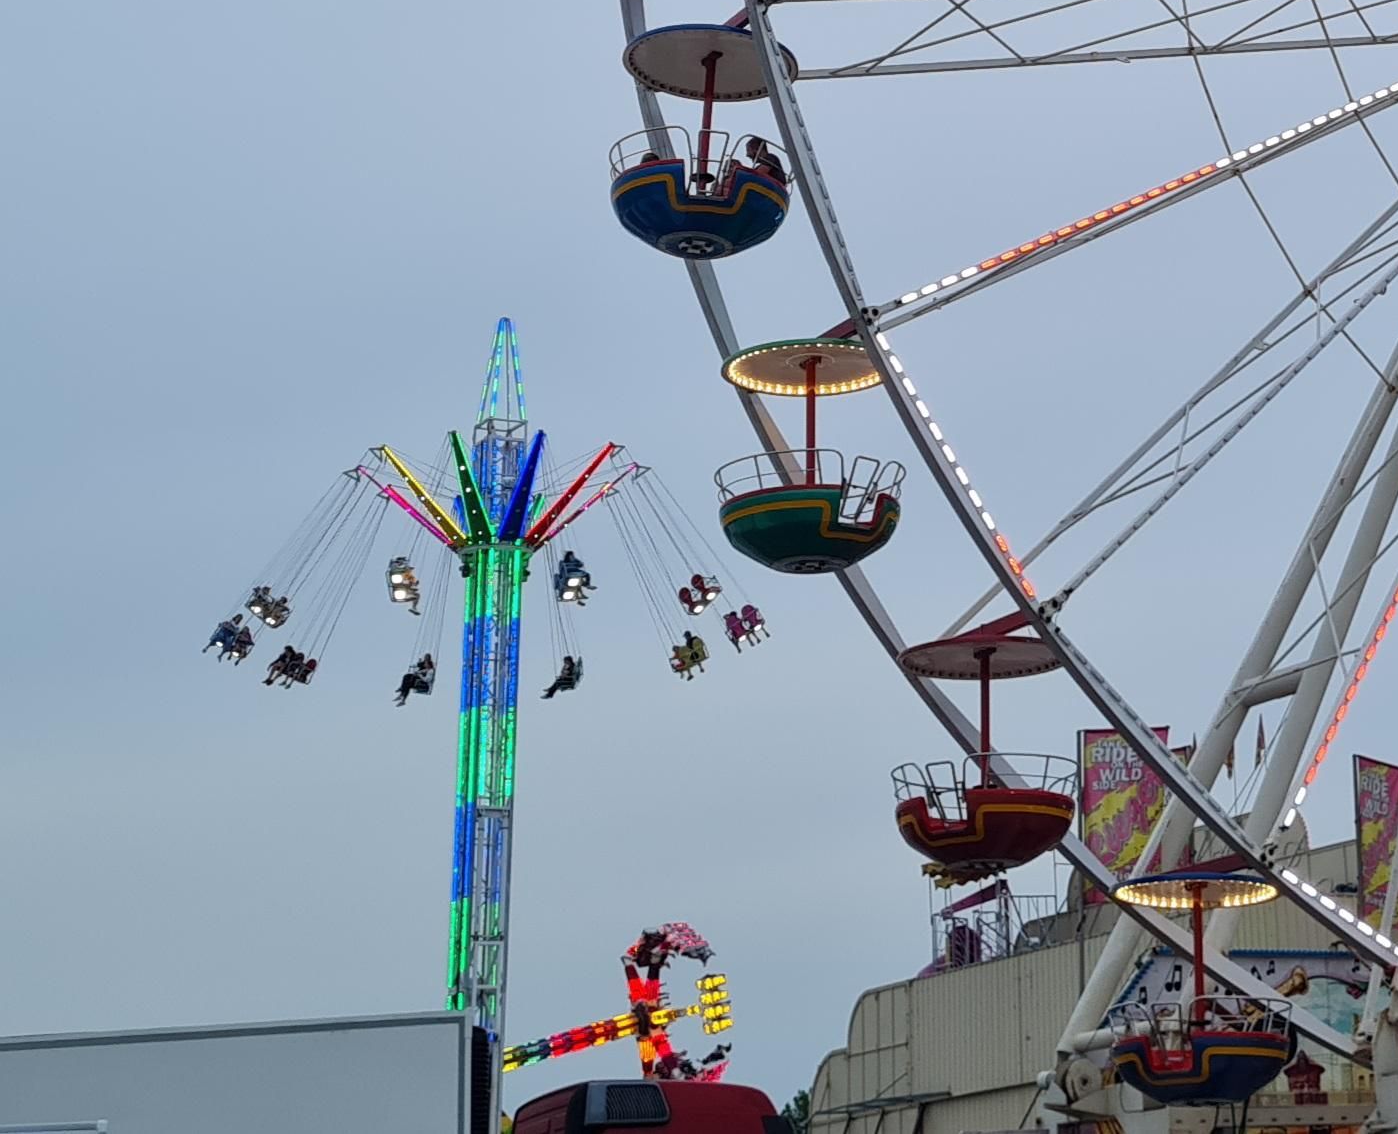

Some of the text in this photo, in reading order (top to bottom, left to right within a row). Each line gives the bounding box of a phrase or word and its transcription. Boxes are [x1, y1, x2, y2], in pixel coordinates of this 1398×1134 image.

[1091, 746, 1138, 763] RIDE
[1099, 768, 1143, 781] WILD
[1091, 780, 1117, 791] SIDE
